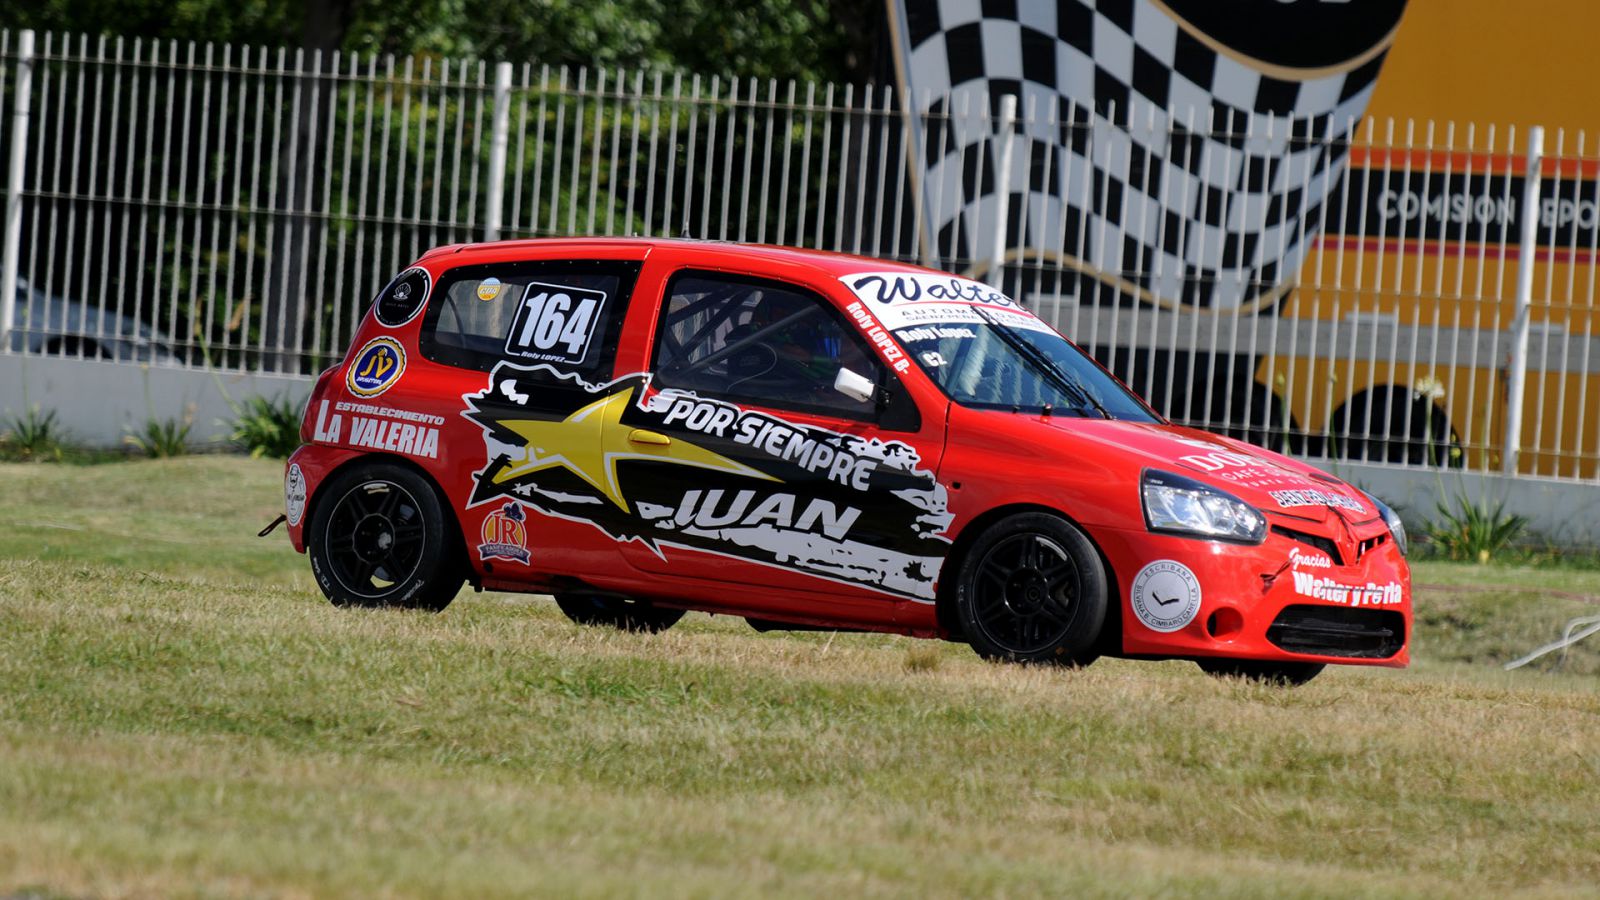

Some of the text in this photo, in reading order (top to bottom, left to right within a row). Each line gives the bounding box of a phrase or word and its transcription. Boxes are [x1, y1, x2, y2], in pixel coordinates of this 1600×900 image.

[1377, 190, 1600, 230] COMSION EPO
[518, 292, 597, 354] 164
[846, 301, 875, 329] Roly
[867, 326, 903, 362] LOPEZ
[540, 354, 565, 362] LOPEZ
[922, 352, 947, 367] C2
[335, 401, 445, 426] ESTABLECIMIENTO
[349, 416, 439, 459] VALERIA
[663, 400, 878, 492] POR SIEMPRE
[487, 514, 521, 546] JR
[674, 489, 862, 540] JUAN
[1144, 564, 1192, 583] ESCRIBANA
[1289, 547, 1331, 570] Gracias
[1291, 570, 1353, 604] Walter
